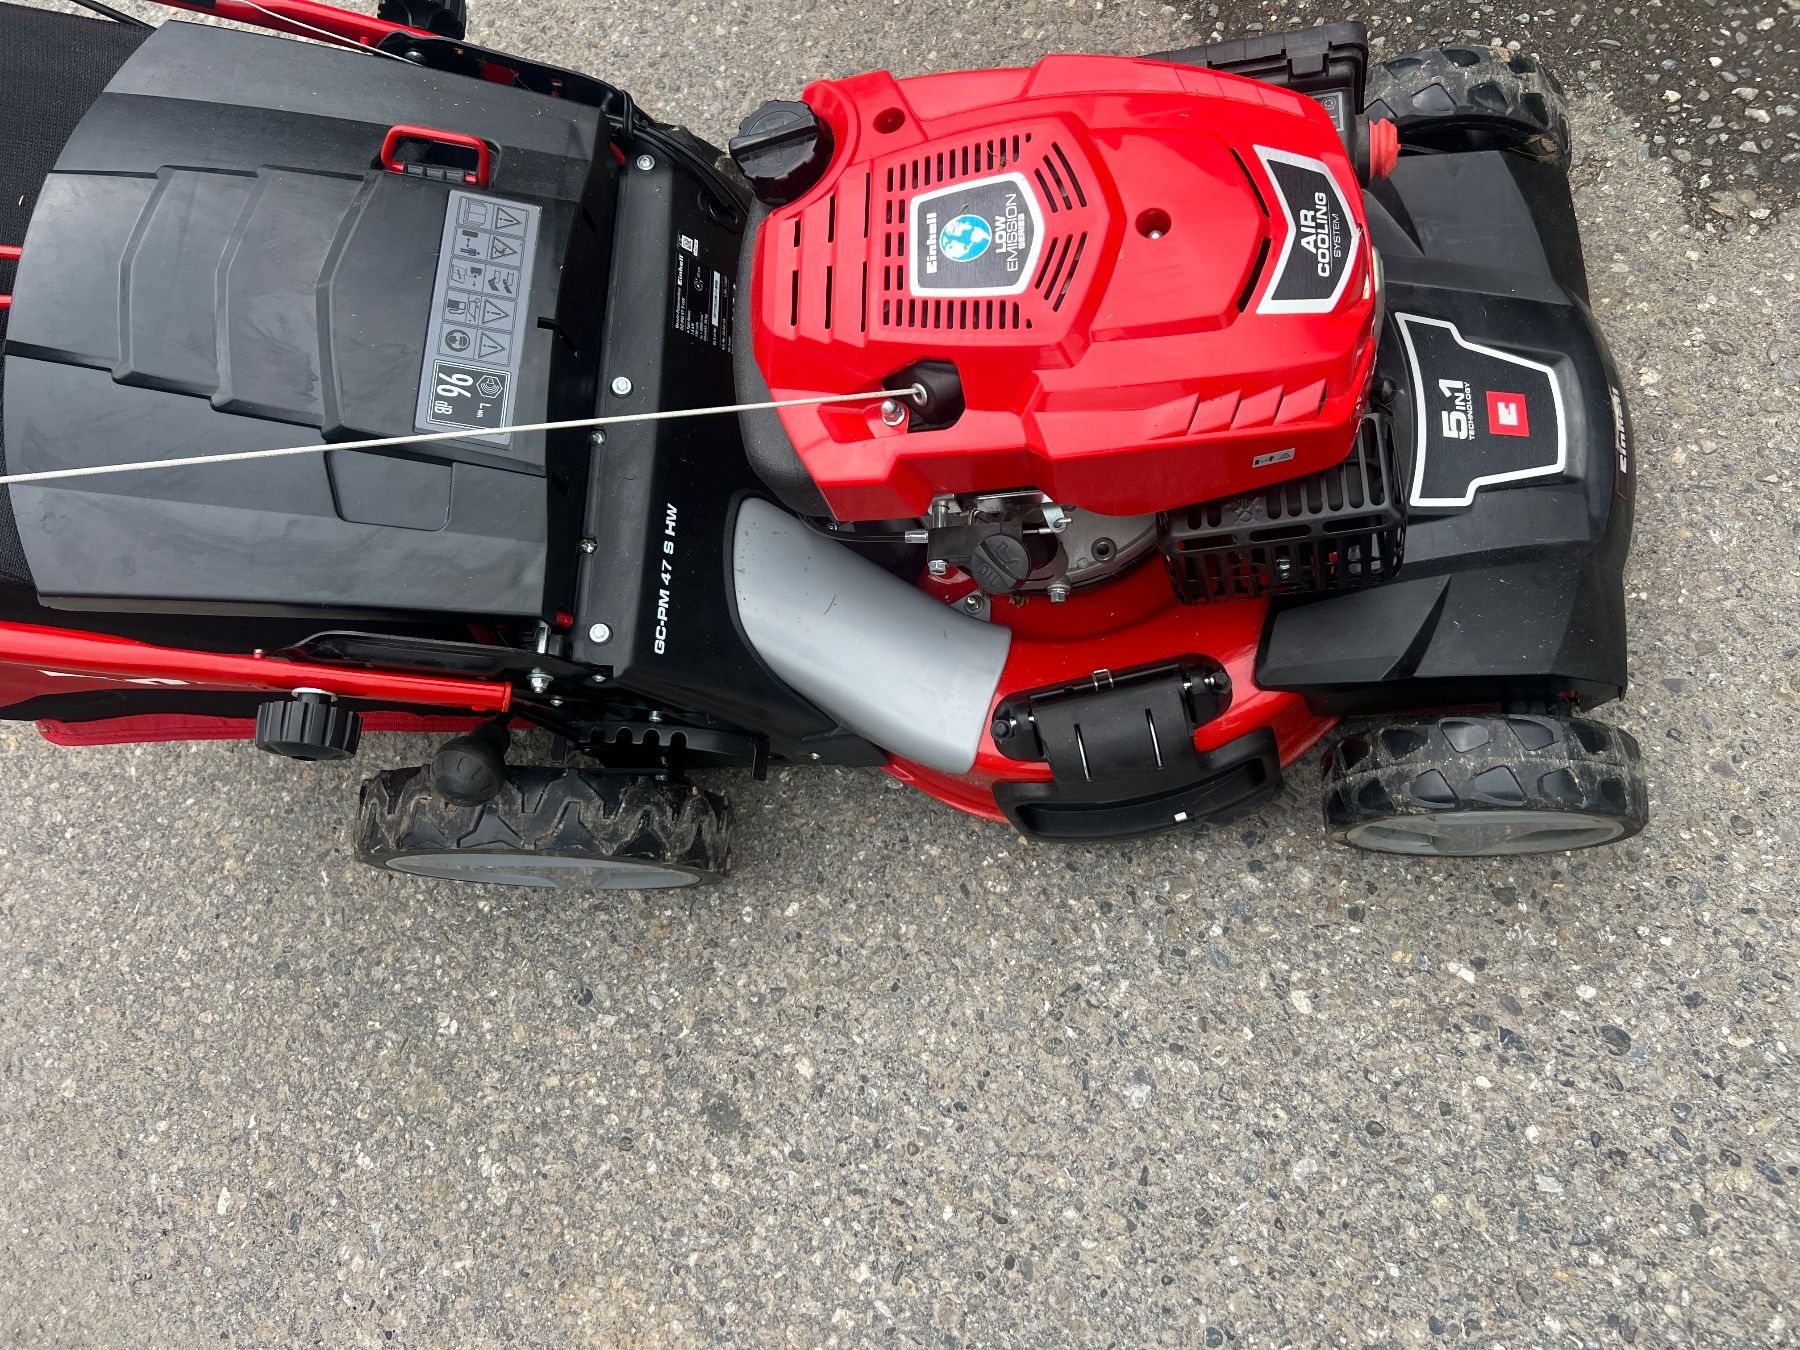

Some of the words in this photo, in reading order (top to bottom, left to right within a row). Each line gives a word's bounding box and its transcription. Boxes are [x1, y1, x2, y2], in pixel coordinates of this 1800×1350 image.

[926, 212, 938, 274] Einhell
[995, 215, 1007, 254] LOW
[1005, 193, 1019, 272] EMISSION
[1017, 212, 1026, 250] SERIES
[1299, 209, 1317, 255] AIR
[1314, 191, 1330, 278] COOLING
[1331, 213, 1341, 258] SYSTEM
[436, 372, 474, 398] 96
[434, 400, 453, 415] dB
[1463, 381, 1476, 441] TECHNOLOGY
[664, 502, 678, 537] HW
[663, 540, 675, 555] S
[660, 559, 672, 586] 47
[654, 588, 670, 655] GC-PM
